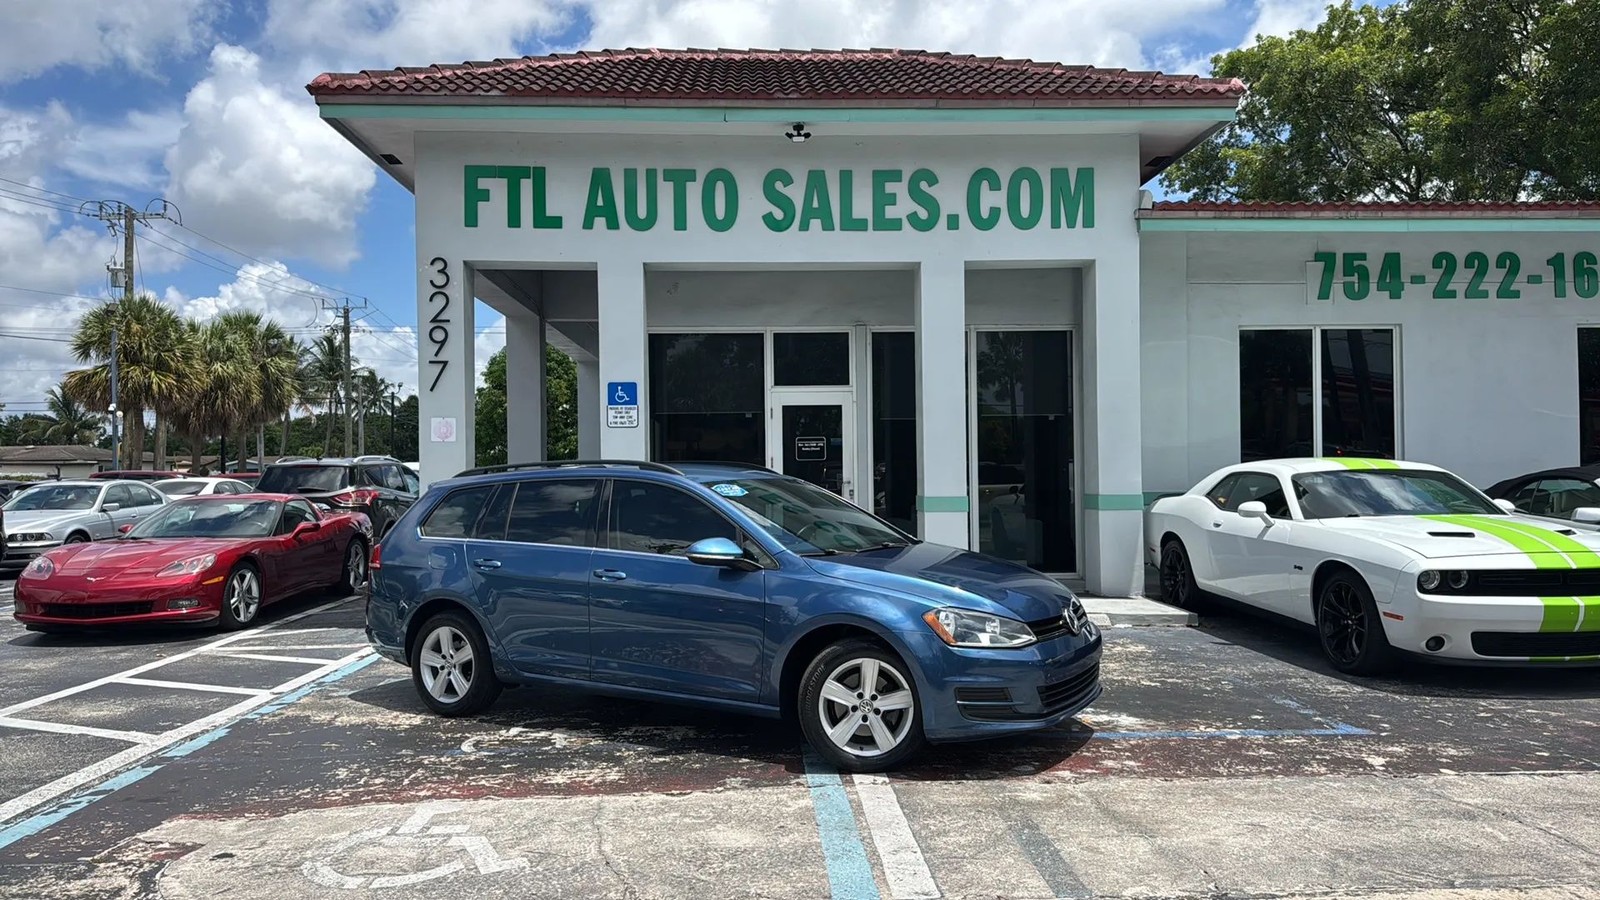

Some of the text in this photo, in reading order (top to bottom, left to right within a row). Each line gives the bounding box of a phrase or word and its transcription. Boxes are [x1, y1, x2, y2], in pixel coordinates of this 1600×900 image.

[464, 165, 1096, 232] FTL AUTO SALES.COM
[1314, 251, 1599, 301] 754-222-16
[428, 257, 450, 392] 3297
[805, 664, 827, 711] IDGESTONE
